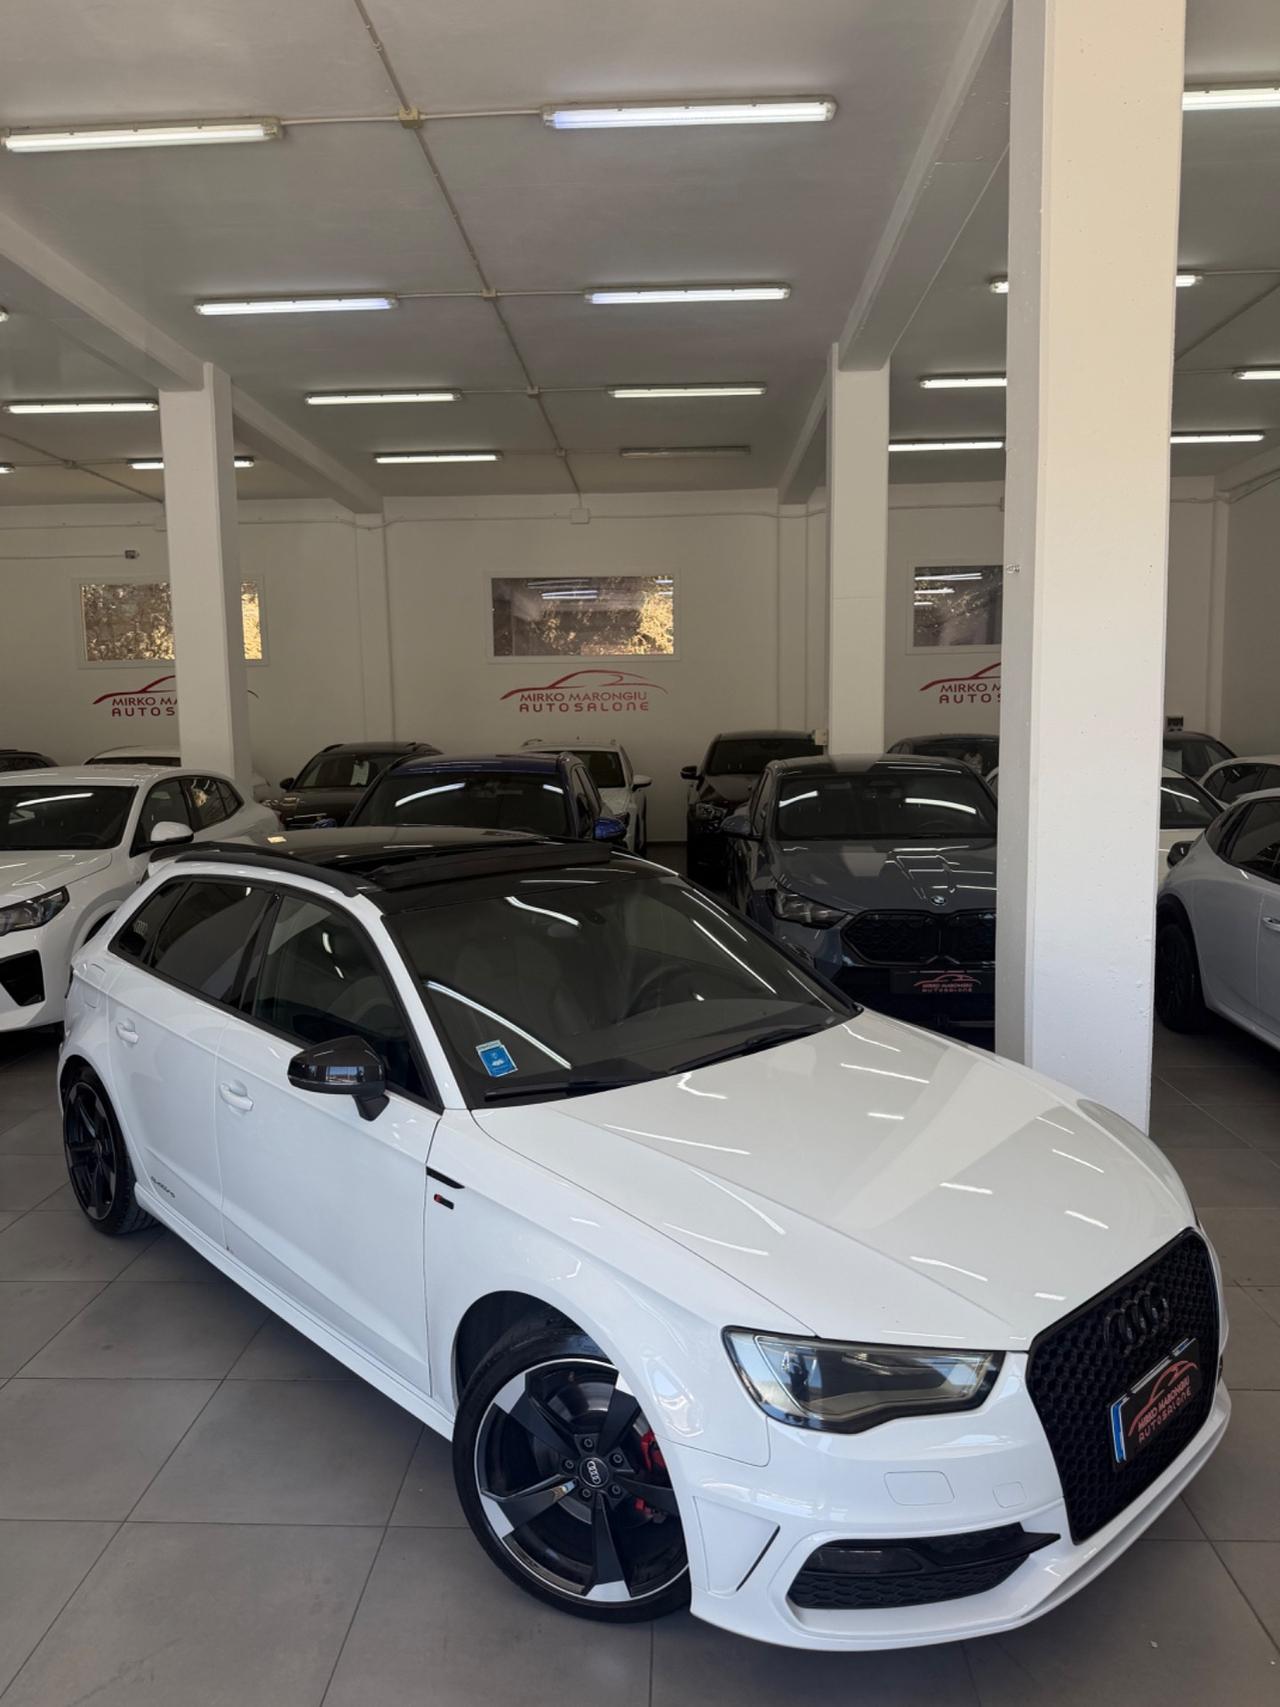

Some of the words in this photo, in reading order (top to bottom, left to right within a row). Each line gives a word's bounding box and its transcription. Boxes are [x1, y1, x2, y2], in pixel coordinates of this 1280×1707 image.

[940, 683, 988, 693] MIRKO
[112, 696, 156, 706] MIRKO
[520, 692, 565, 702] MIRKO
[569, 691, 648, 702] MARONGIU
[519, 702, 649, 713] AUTOSALONE
